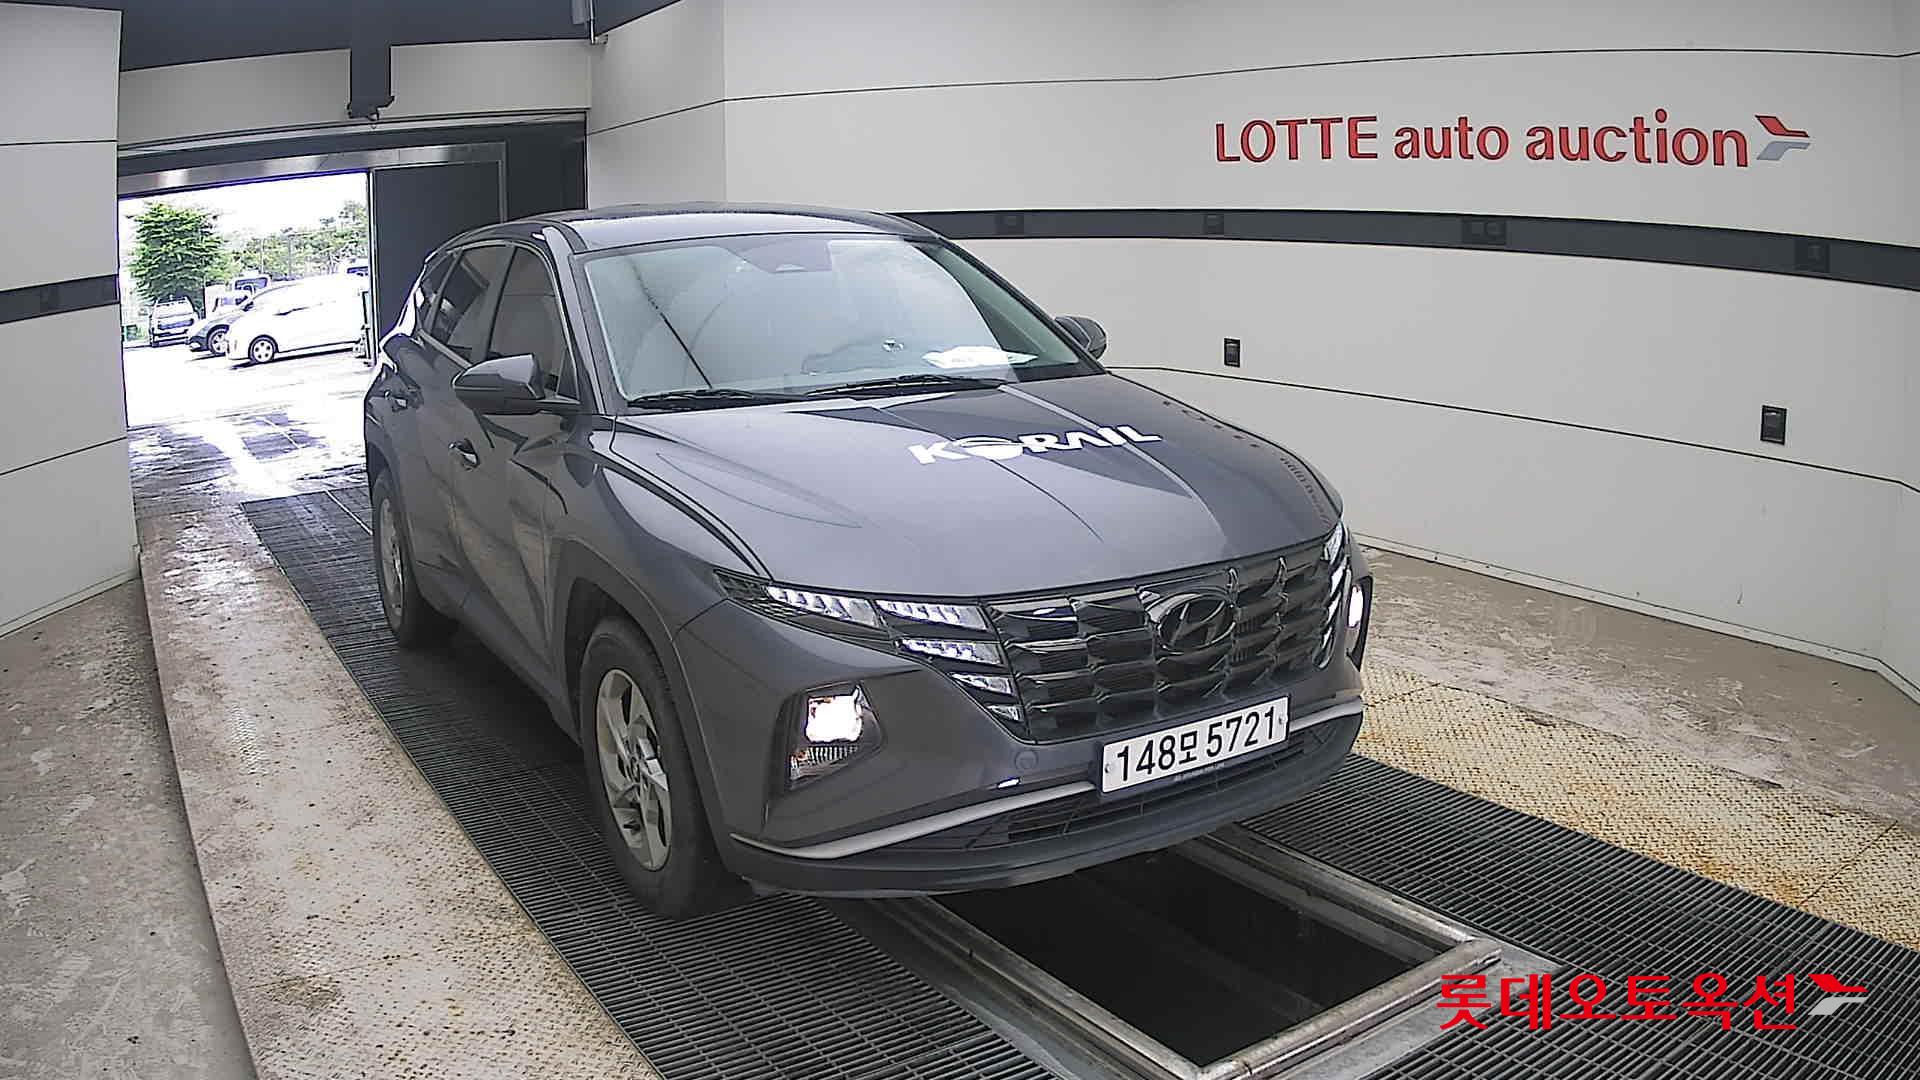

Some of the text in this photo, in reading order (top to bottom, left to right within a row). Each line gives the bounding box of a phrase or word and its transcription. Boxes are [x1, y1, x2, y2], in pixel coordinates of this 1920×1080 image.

[1215, 109, 1749, 168] LOTTE auto auction
